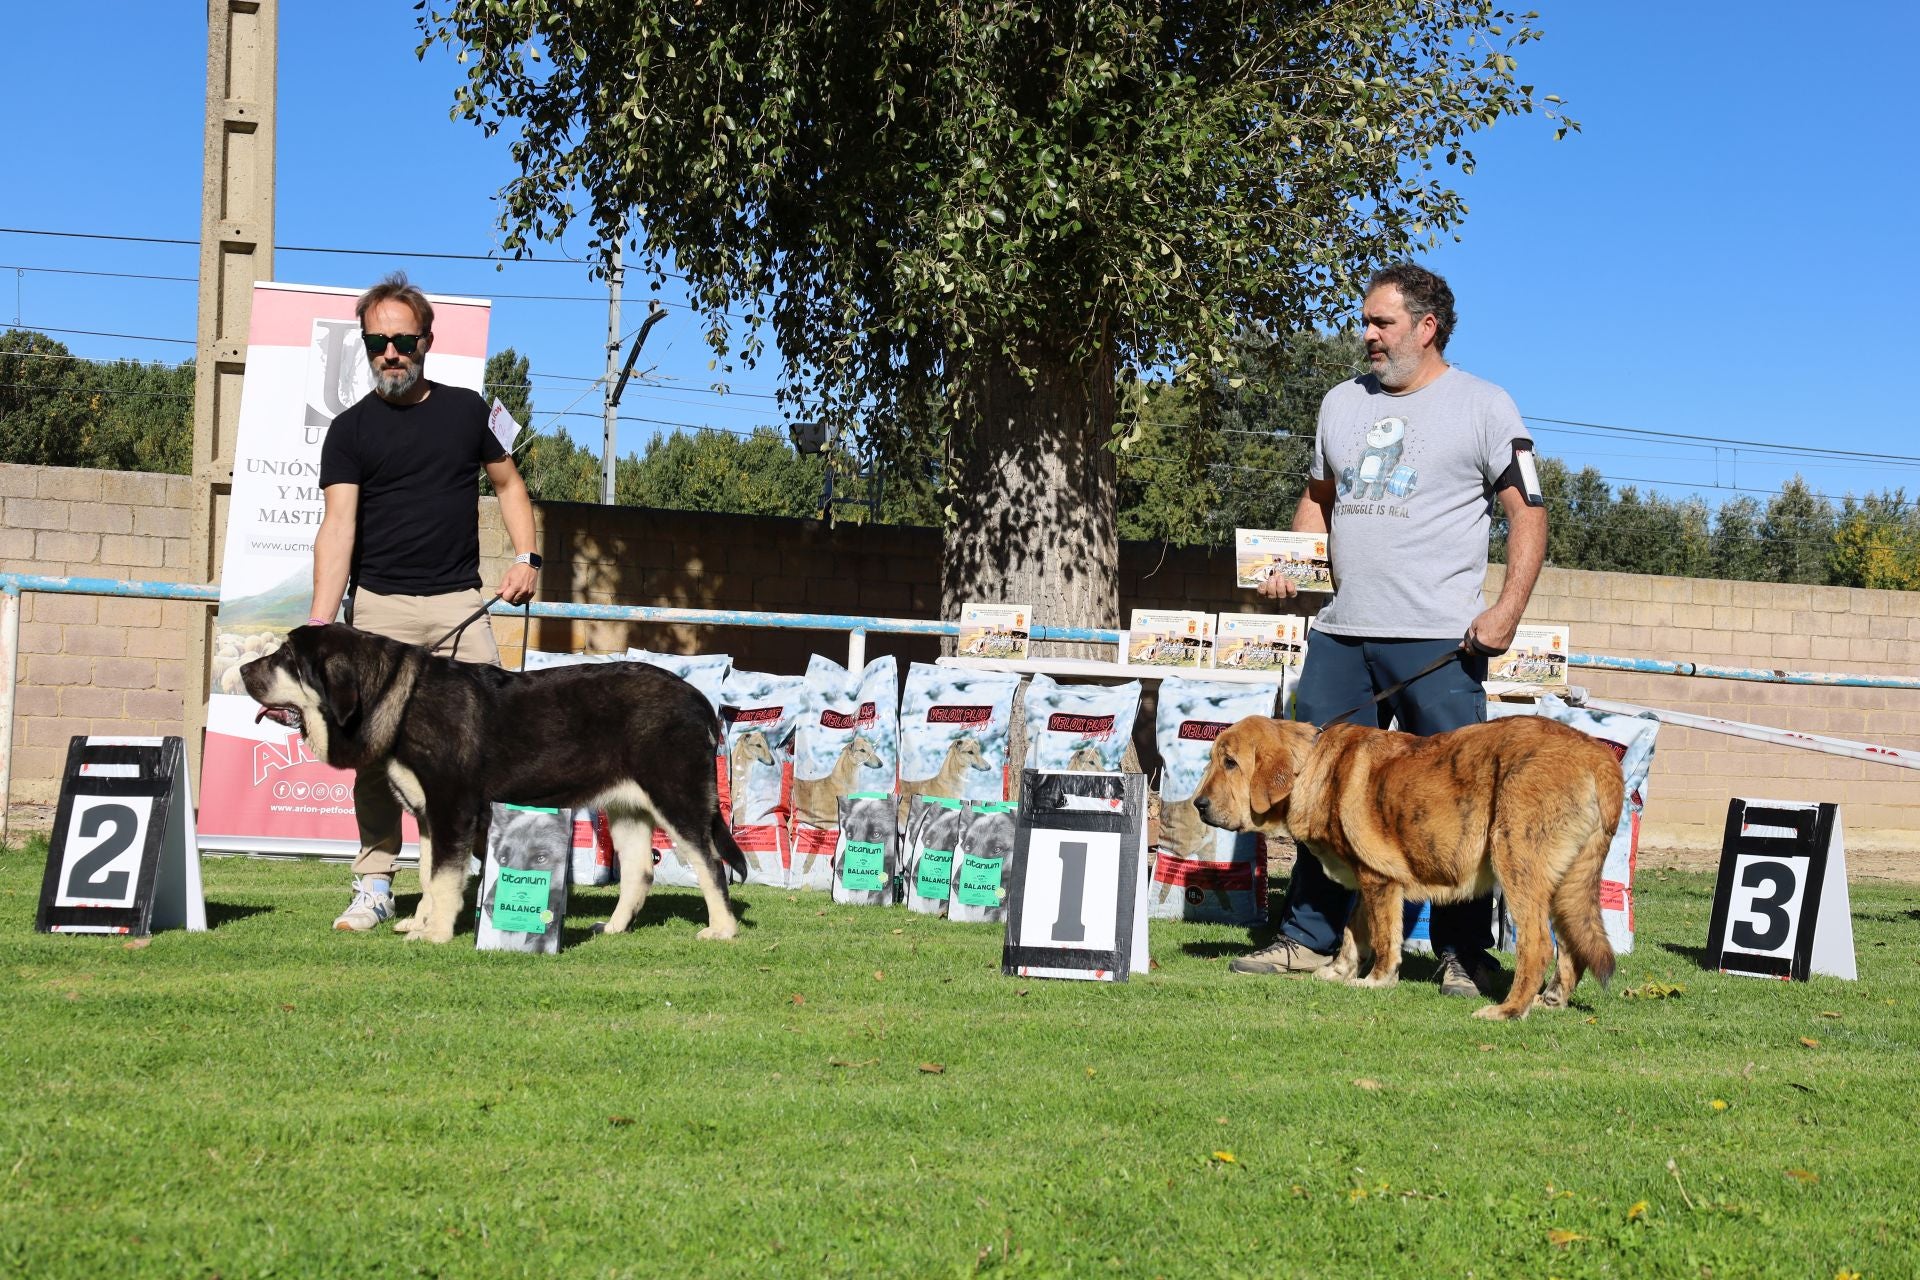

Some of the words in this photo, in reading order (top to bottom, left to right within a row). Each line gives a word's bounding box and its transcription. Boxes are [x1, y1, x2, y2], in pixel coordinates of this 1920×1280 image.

[246, 458, 321, 477] UNIÓN
[277, 485, 291, 500] Y
[1341, 504, 1374, 516] STRUGGLE
[1376, 504, 1386, 516] IS
[1388, 505, 1410, 519] REAL
[930, 708, 963, 721] VELOX
[963, 708, 992, 721] PLUS
[1051, 716, 1086, 731] VELOX
[1085, 717, 1113, 732] PLUS
[1181, 723, 1219, 739] VELOX
[66, 803, 138, 900] 2
[847, 844, 882, 855] titanium
[965, 858, 1000, 870] titanium
[501, 872, 547, 886] titanium
[847, 868, 879, 876] BALANCE
[921, 875, 950, 885] BALANCE
[963, 883, 996, 891] BALANCE
[1051, 841, 1088, 942] 1
[500, 903, 541, 914] BALANCE
[1731, 861, 1797, 951] 3
